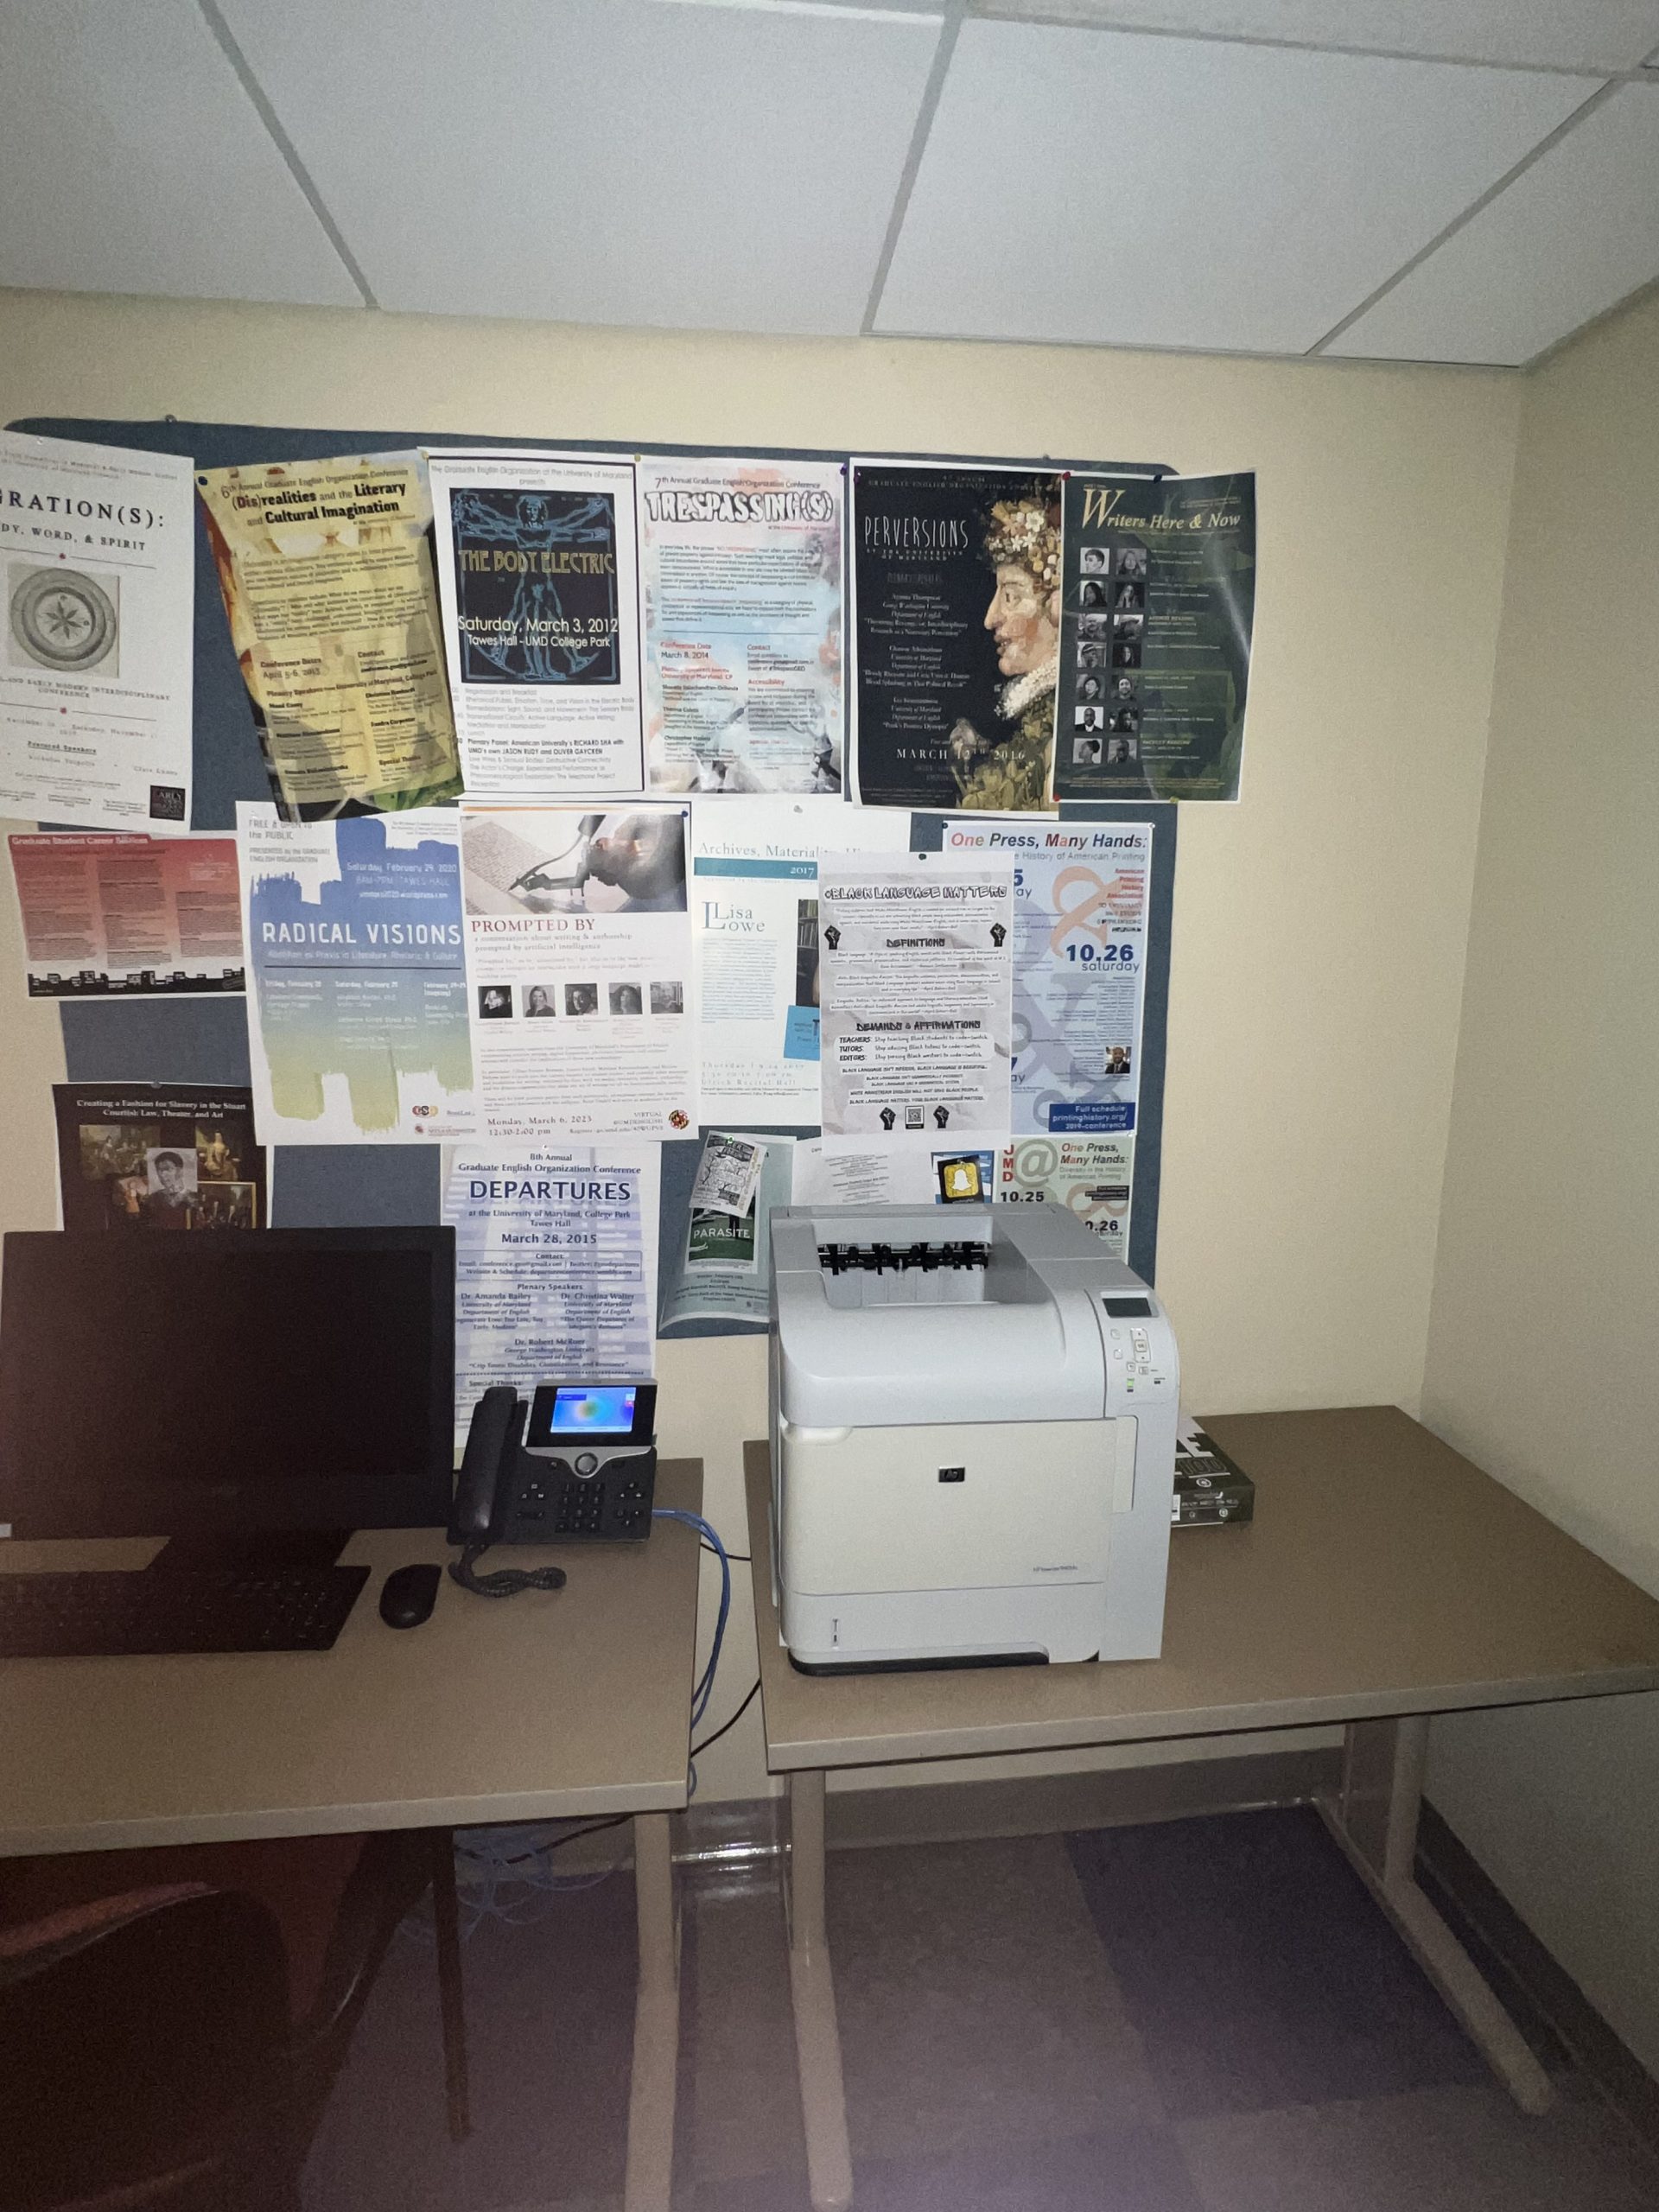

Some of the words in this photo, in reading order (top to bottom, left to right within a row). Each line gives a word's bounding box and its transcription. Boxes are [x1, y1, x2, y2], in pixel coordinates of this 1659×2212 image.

[655, 478, 669, 488] 7th
[722, 479, 743, 487] English
[320, 492, 335, 500] and
[339, 489, 353, 499] the
[354, 482, 405, 496] Literary
[0, 489, 163, 529] RATION(S):
[265, 506, 319, 524] Cultural
[321, 500, 399, 519] Imagination
[1082, 488, 1146, 529] Writers
[1150, 515, 1184, 529] Here
[1189, 513, 1202, 528] &
[1208, 513, 1241, 527] Now
[32, 527, 77, 543] WORD,
[101, 537, 145, 550] SPIRIT
[866, 515, 968, 549] PERVERSIONS
[459, 550, 488, 571] THE
[493, 551, 537, 572] BODY
[541, 552, 615, 574] ELECTRIC
[458, 615, 522, 633] Saturday,
[526, 618, 569, 632] March
[573, 619, 584, 633] 3,
[588, 619, 619, 632] 2012
[468, 634, 498, 645] Tawes
[500, 635, 518, 646] Hall
[525, 636, 548, 646] UMD
[550, 637, 588, 648] College
[590, 637, 610, 647] Park
[897, 749, 948, 760] MARCH
[994, 750, 1025, 760] 2016
[951, 833, 984, 847] One
[989, 833, 1039, 849] Press,
[1046, 834, 1088, 850] Many
[1093, 834, 1147, 849] Hands:
[699, 843, 760, 856] Archives,
[1022, 852, 1052, 861] History
[1067, 852, 1108, 861] American
[1112, 853, 1145, 861] Printing
[791, 867, 814, 878] 2017
[874, 886, 940, 899] LANGUAGE
[944, 886, 1007, 899] MATTERS
[702, 901, 765, 932] Lowe
[713, 901, 753, 919] Lisa
[472, 918, 568, 932] PROMPTED
[575, 919, 595, 931] BY
[263, 922, 357, 944] RADICAL
[366, 923, 461, 944] VISIONS
[887, 938, 944, 948] DEFINITIONS
[1066, 944, 1134, 962] 10.26
[1082, 962, 1140, 973] saturday
[857, 1022, 902, 1031] DEMANDS
[914, 1020, 981, 1030] AFFIRMATIONS
[1062, 1143, 1084, 1152] One
[1086, 1143, 1118, 1153] Press,
[1060, 1154, 1089, 1166] Many
[1093, 1155, 1129, 1164] Hands:
[458, 1163, 499, 1172] Graduate
[502, 1164, 531, 1174] English
[535, 1165, 590, 1174] Organization
[594, 1166, 641, 1174] Conference
[470, 1180, 631, 1201] DEPARTURES
[1001, 1192, 1044, 1202] 10.25
[493, 1210, 531, 1219] University
[544, 1210, 582, 1219] Maryland,
[585, 1211, 613, 1219] College
[502, 1233, 538, 1243] March
[544, 1234, 562, 1245] 28,
[567, 1234, 597, 1243] 2015
[694, 1229, 750, 1239] PARASITE
